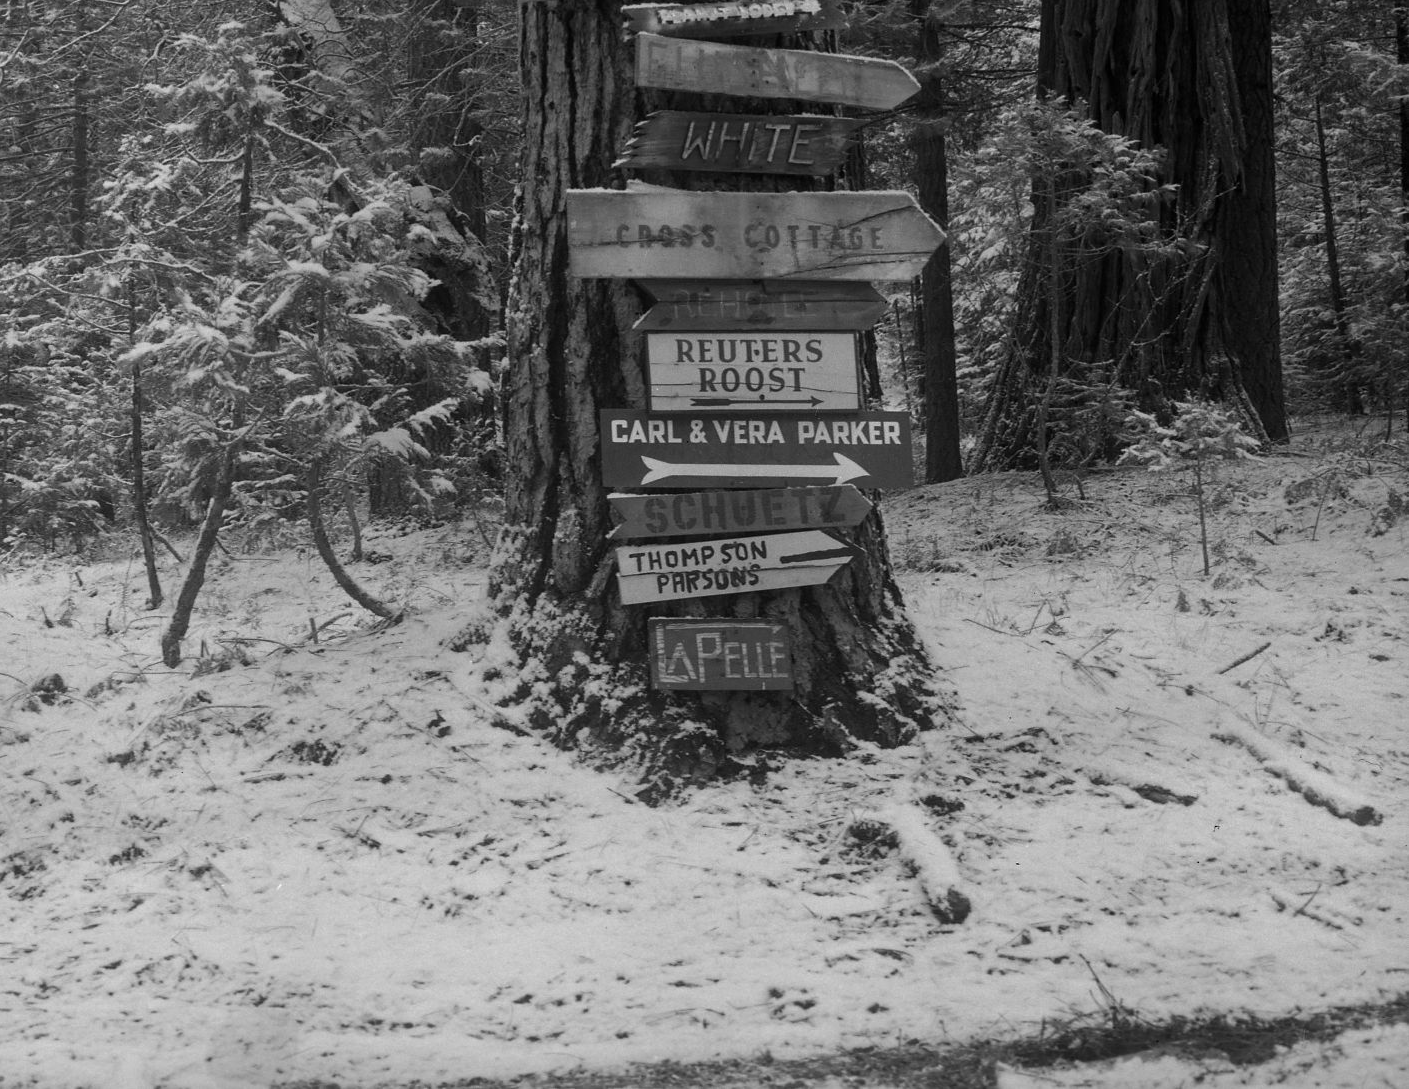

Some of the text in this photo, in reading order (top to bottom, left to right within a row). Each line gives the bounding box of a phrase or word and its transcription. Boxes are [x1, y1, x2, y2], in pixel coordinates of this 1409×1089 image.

[615, 222, 885, 251] CROSS COTTAGE
[675, 339, 824, 363] REUTERS
[699, 366, 806, 393] ROOST
[611, 419, 902, 446] CARL & VERA PARKER
[645, 486, 846, 534] SCHUETZ
[629, 540, 768, 574] THOMPSON
[656, 564, 762, 595] PARSONS
